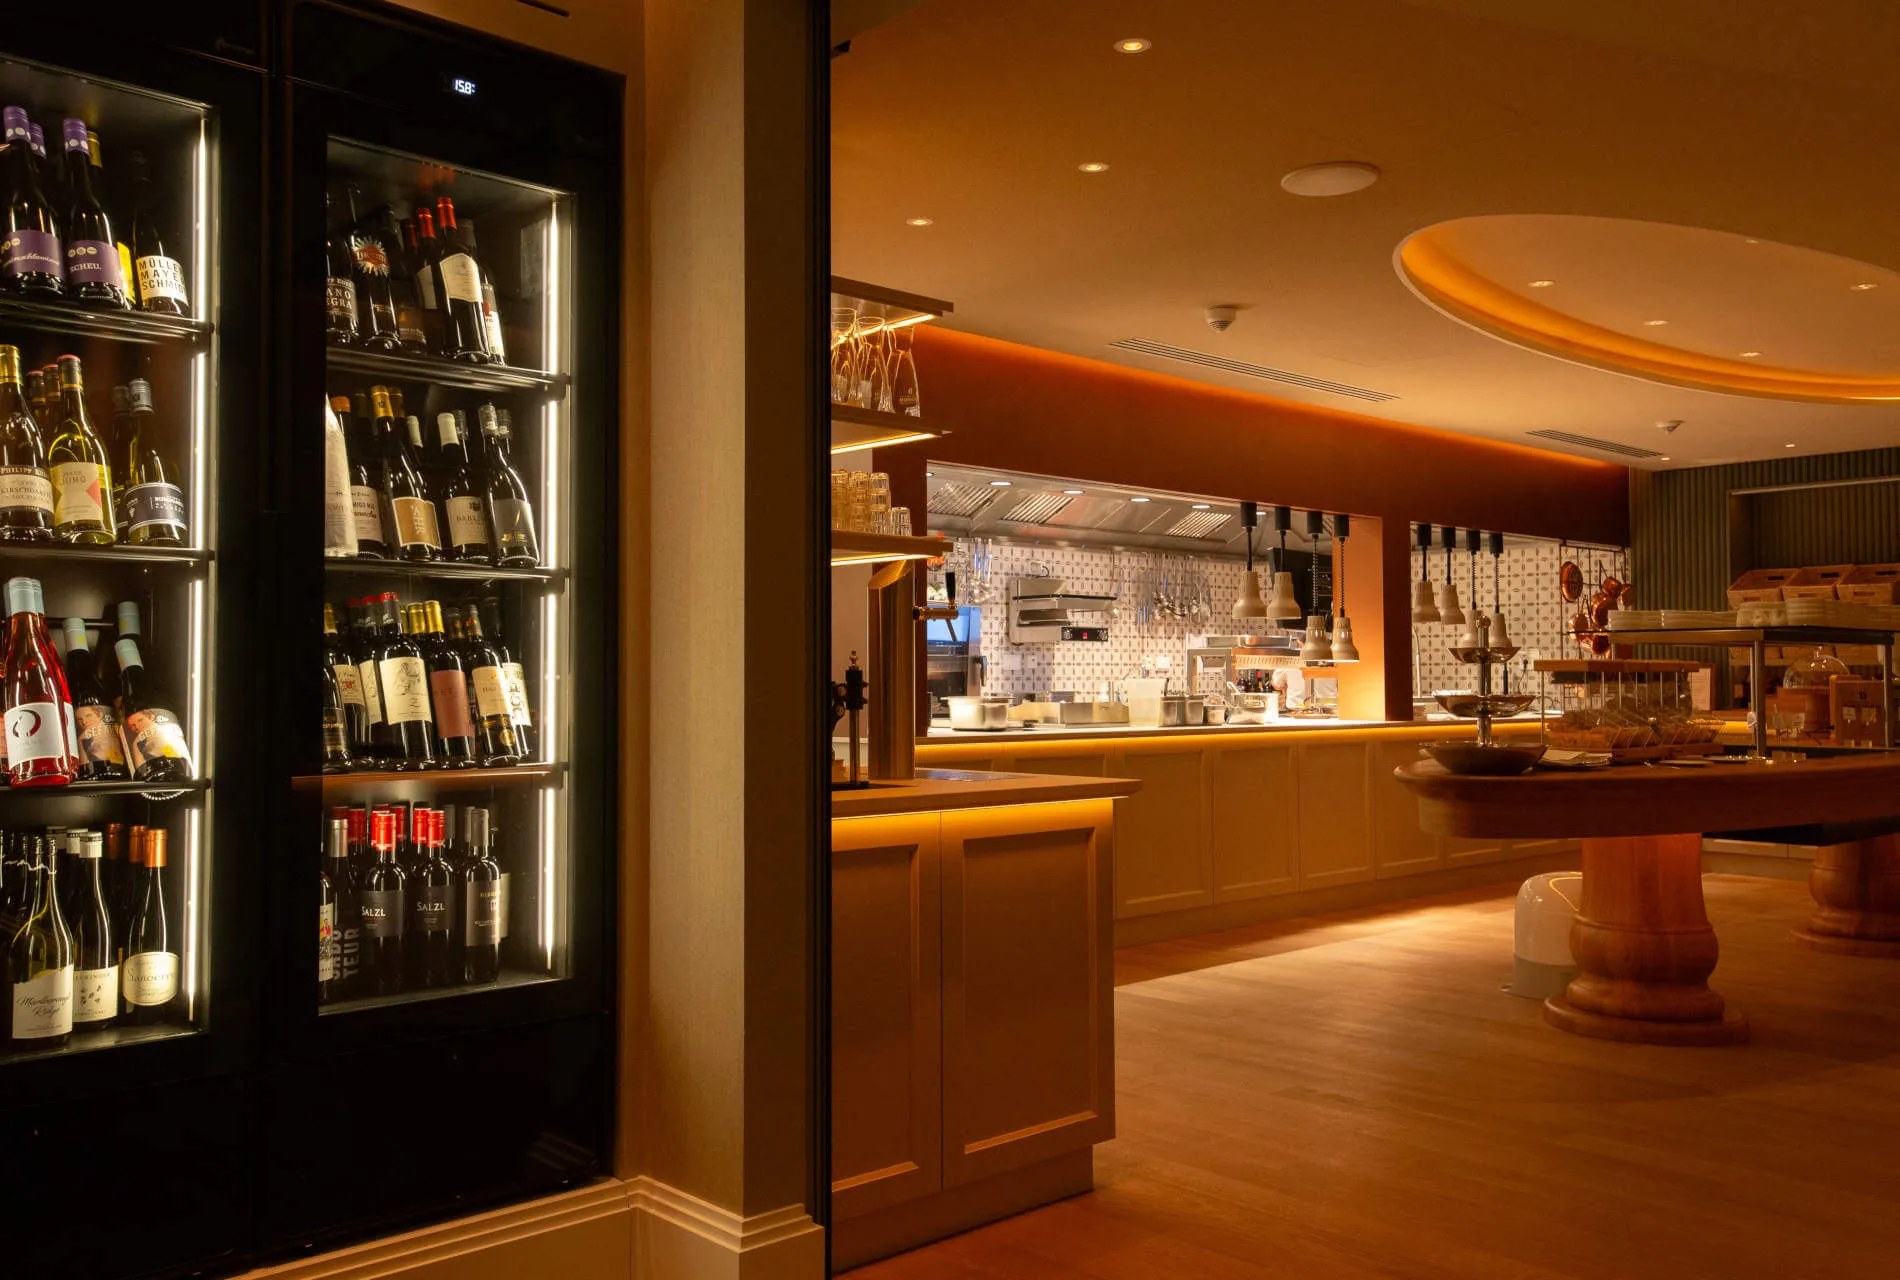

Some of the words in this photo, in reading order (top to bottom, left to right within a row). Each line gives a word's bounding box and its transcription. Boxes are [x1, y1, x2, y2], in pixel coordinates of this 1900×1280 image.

[139, 257, 181, 273] MÜLLE
[326, 287, 351, 300] ANO
[361, 905, 386, 917] SALZL
[416, 901, 446, 912] SALZL
[343, 927, 360, 979] TEUR
